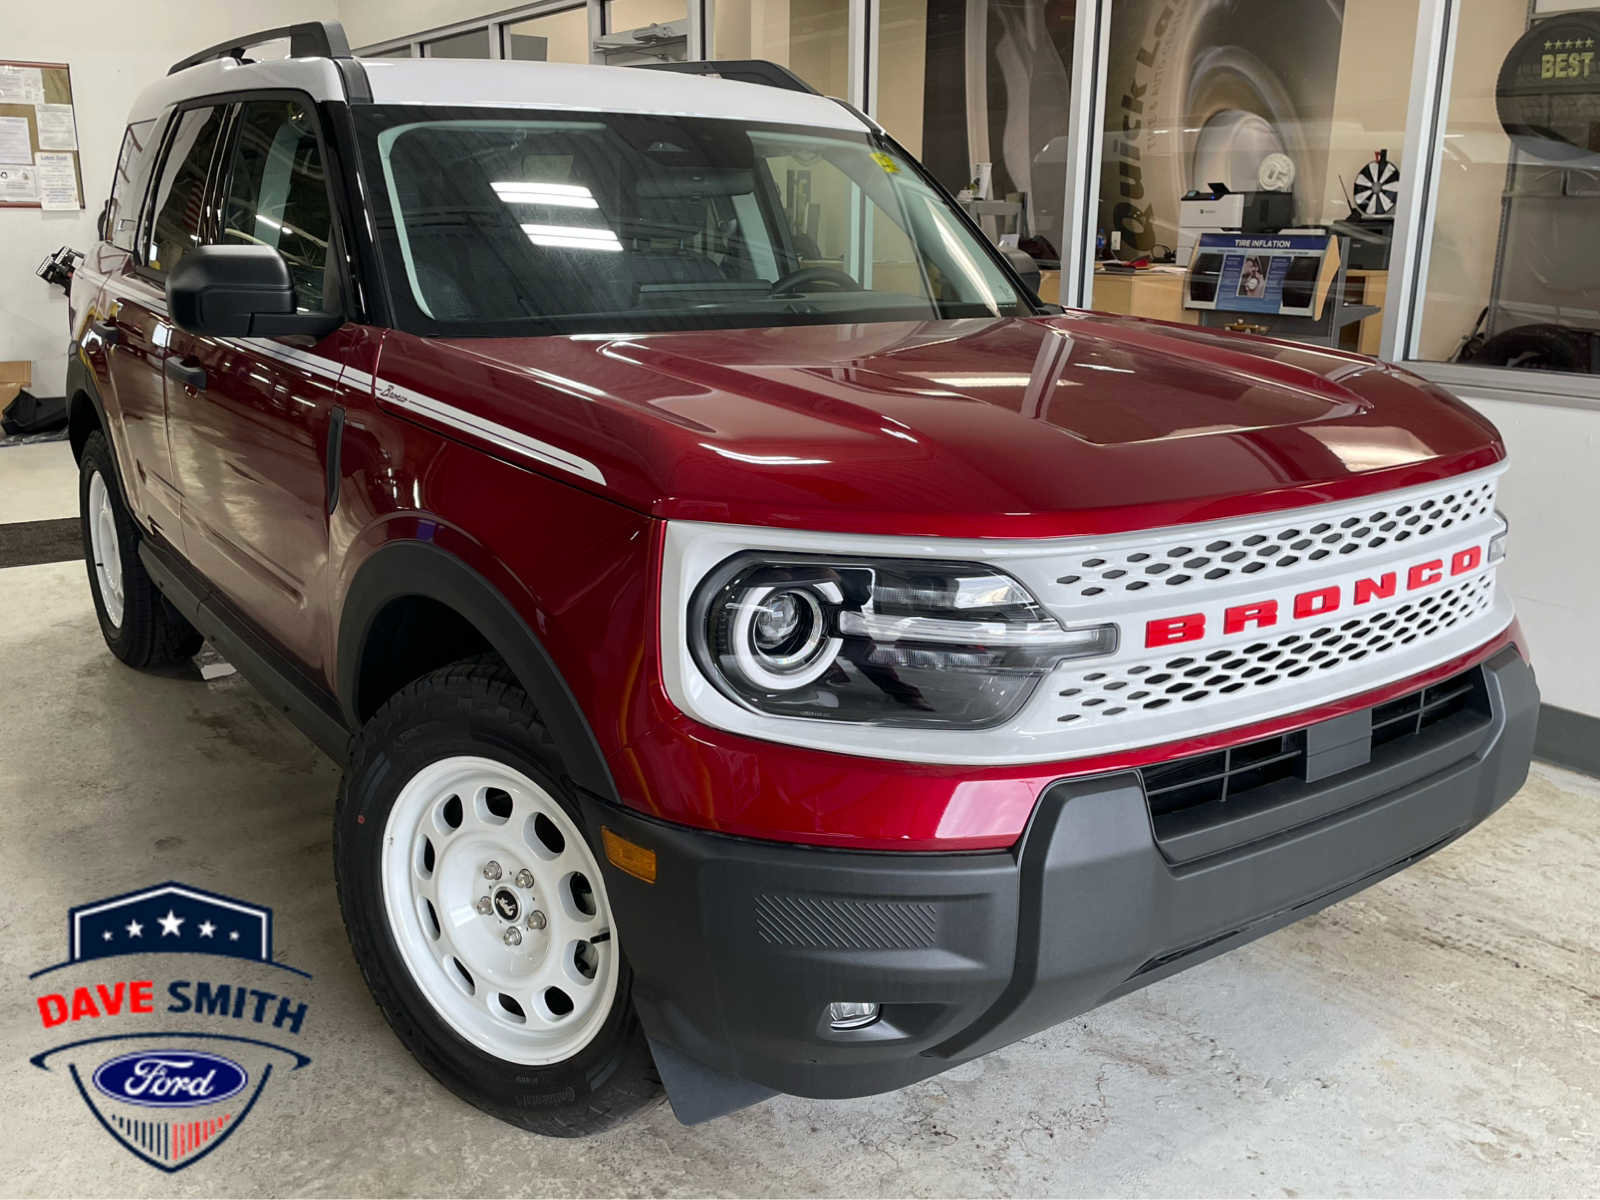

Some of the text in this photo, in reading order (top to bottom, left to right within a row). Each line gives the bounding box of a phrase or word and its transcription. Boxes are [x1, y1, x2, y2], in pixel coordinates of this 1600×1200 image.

[1541, 52, 1594, 79] BEST
[1113, 78, 1156, 251] Quick
[1235, 239, 1291, 248] TIRE INFLATION
[1145, 545, 1482, 648] BRONCO
